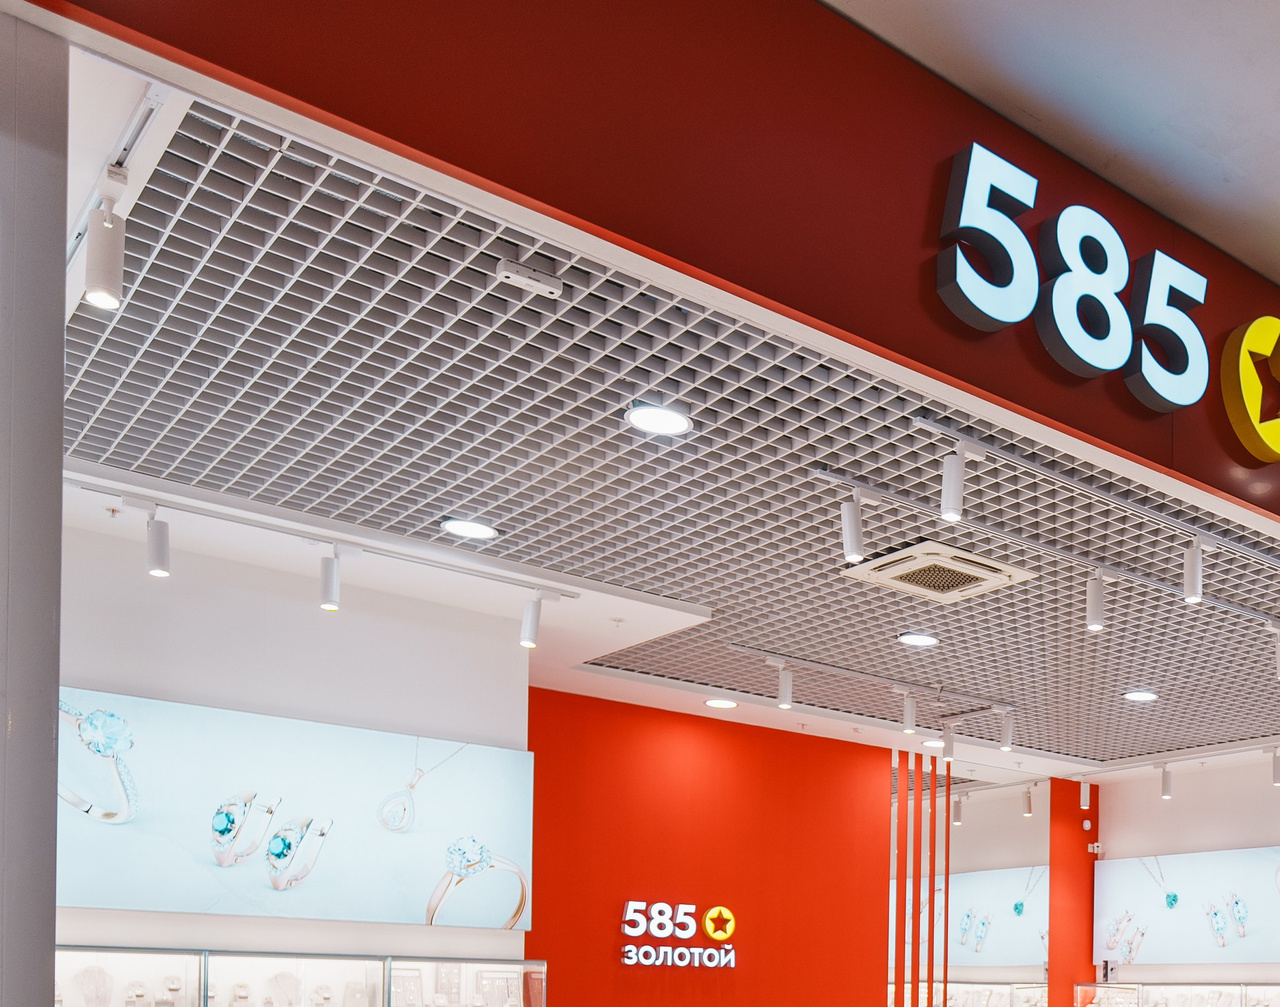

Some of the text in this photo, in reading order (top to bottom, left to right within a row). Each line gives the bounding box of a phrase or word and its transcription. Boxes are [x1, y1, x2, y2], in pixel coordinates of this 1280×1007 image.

[953, 141, 1210, 408] 585
[622, 901, 696, 938] 585
[622, 944, 736, 968] ЗОЛОТОЙ
